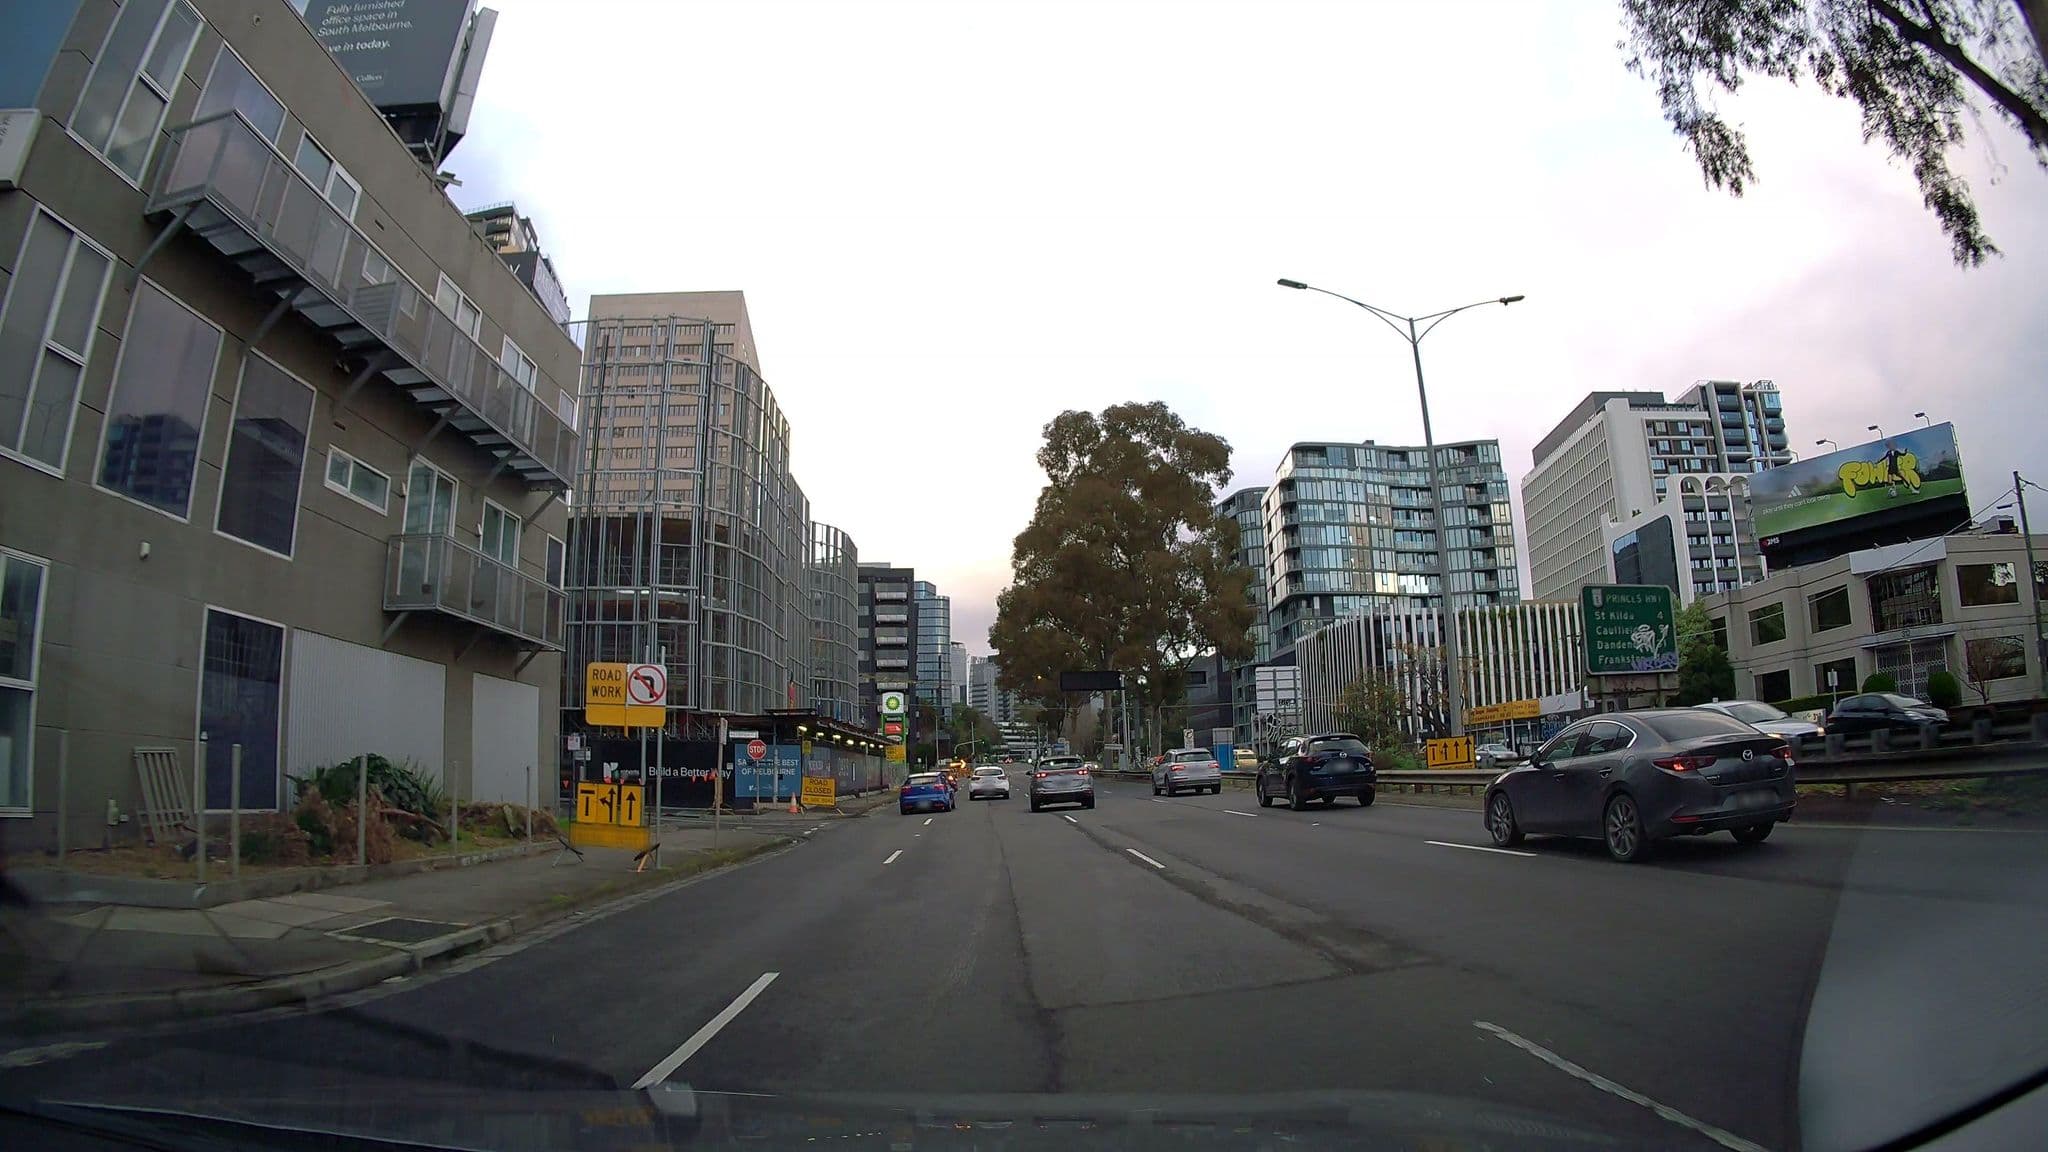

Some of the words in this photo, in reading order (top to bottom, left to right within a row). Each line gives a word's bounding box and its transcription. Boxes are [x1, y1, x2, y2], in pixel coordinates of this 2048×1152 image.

[327, 4, 352, 15] Fully
[353, 0, 406, 12] furnished
[322, 14, 351, 26] office
[352, 12, 386, 24] space
[387, 11, 398, 19] in
[318, 24, 349, 37] South
[351, 20, 414, 33] Melbourne.
[343, 43, 354, 51] in
[356, 40, 391, 50] today.
[1606, 593, 1642, 603] PRINCES
[1594, 611, 1606, 620] St
[1609, 611, 1635, 620] Kilda
[1656, 611, 1664, 620] 4
[592, 669, 622, 681] ROAD
[591, 685, 622, 697] WORK
[749, 745, 765, 754] STOP
[672, 768, 680, 777] a
[680, 766, 710, 777] Better
[809, 778, 829, 786] ROAD
[805, 786, 832, 794] CLOSED
